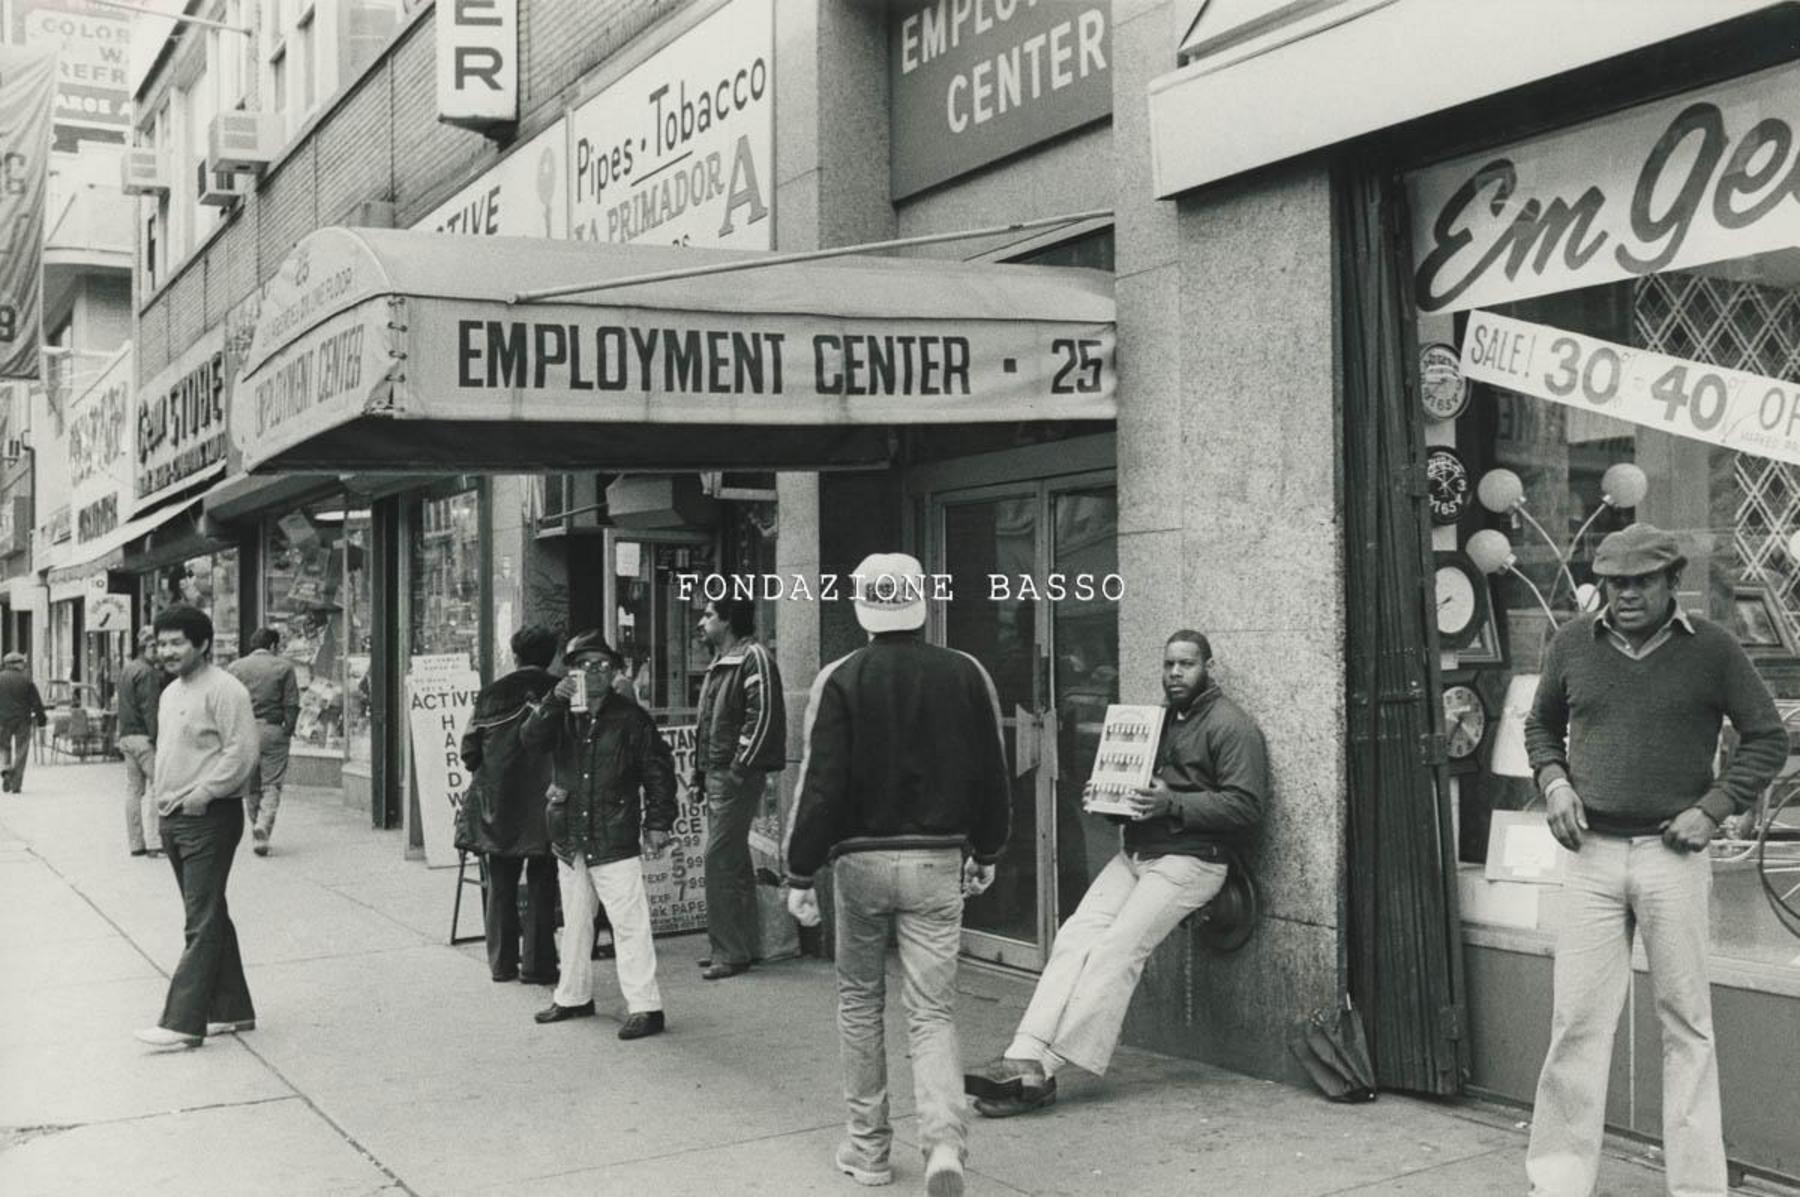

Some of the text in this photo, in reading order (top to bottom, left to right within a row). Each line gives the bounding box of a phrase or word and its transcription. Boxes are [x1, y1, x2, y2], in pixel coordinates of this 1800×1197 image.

[947, 8, 1107, 133] CENTER
[578, 57, 766, 205] Pipes Tobacco
[318, 323, 364, 404] CENTER
[459, 320, 1102, 395] EMPLOYMENT CENTER 25
[1471, 324, 1537, 378] SALE!
